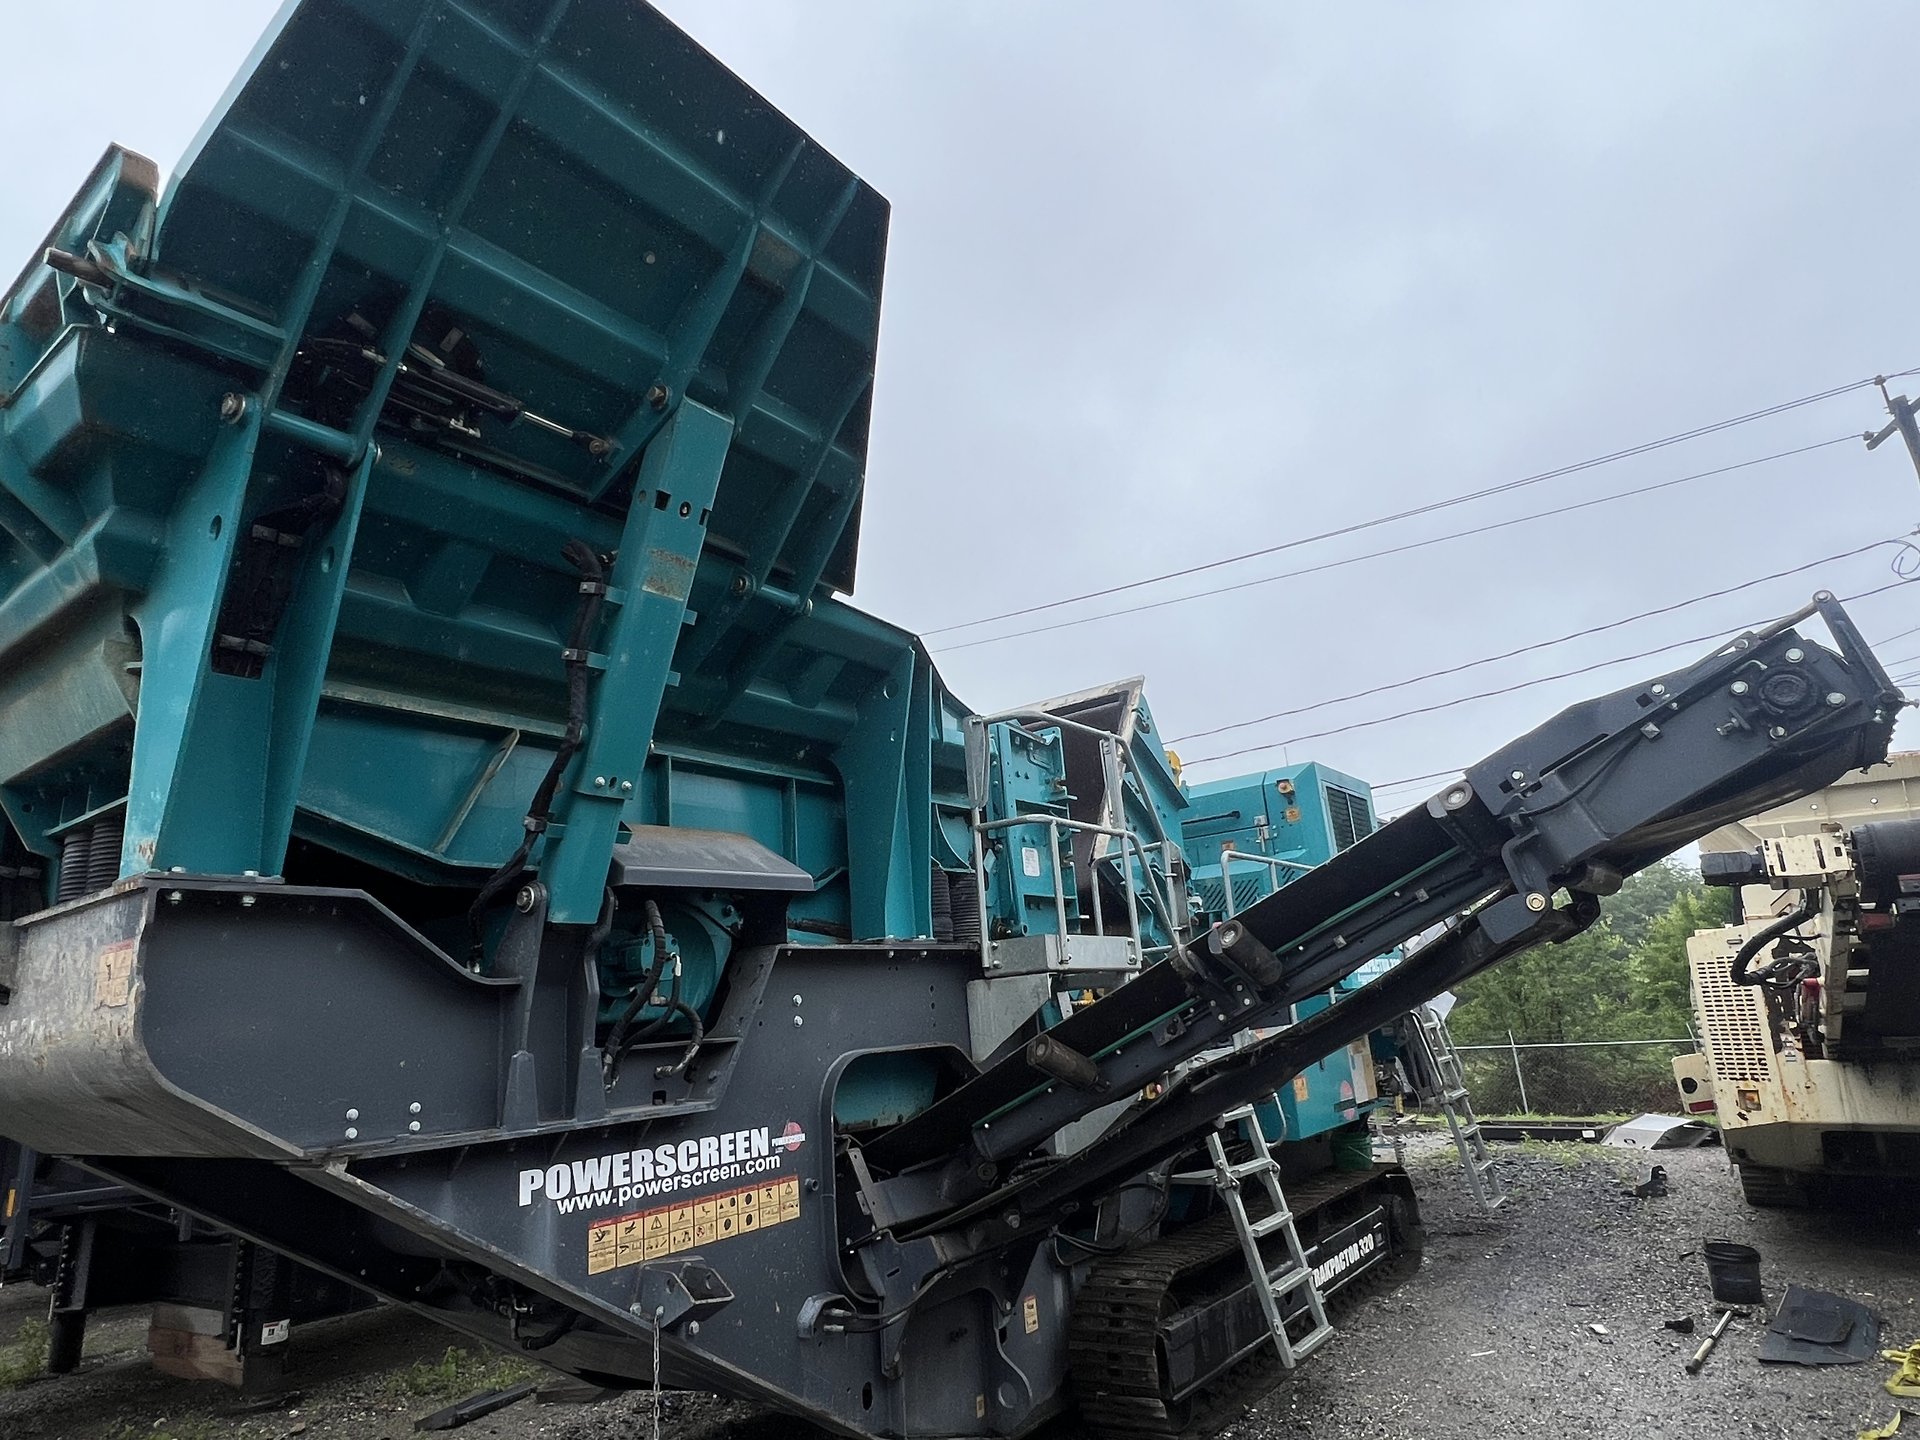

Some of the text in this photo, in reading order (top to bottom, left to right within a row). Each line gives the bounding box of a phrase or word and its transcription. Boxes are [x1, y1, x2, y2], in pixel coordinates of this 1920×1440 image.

[519, 1126, 769, 1206] POWERSCREEN
[556, 1154, 781, 1215] www.powerscreen.com
[1312, 1233, 1374, 1288] RAKPACTOR 320
